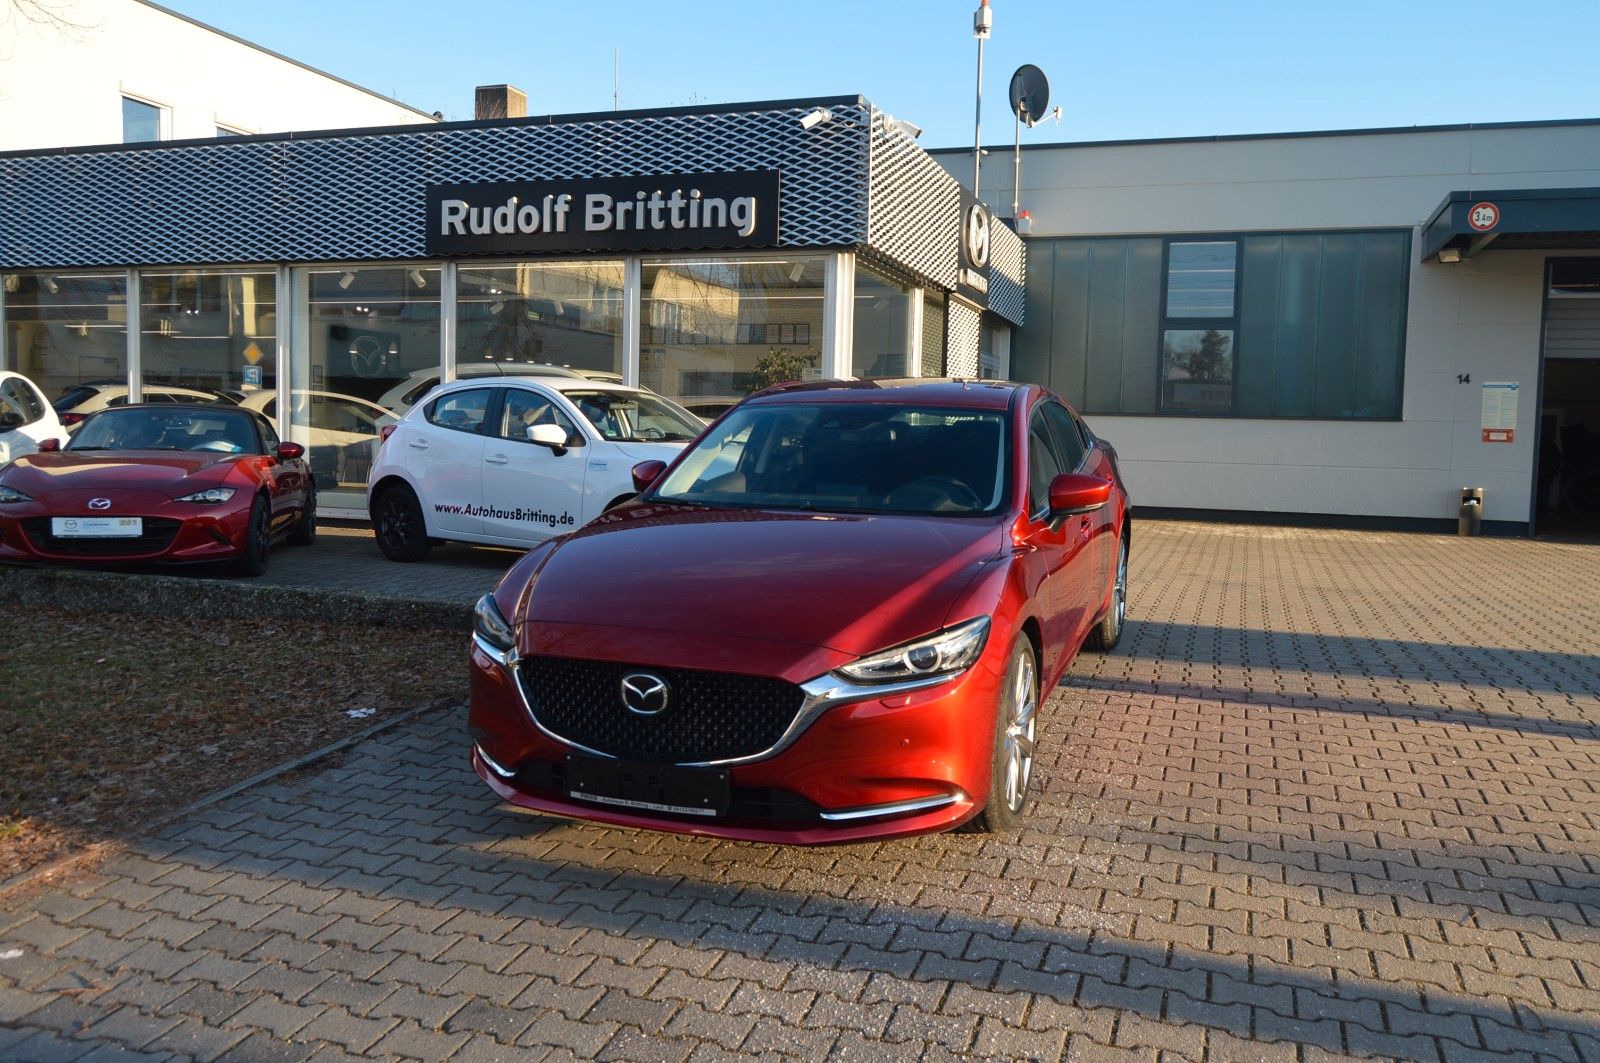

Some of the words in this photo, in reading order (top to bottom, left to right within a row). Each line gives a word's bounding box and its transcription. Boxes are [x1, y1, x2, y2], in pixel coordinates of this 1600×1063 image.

[441, 193, 572, 237] Rudolf
[585, 188, 756, 238] Britting
[1457, 374, 1471, 385] 14
[434, 503, 575, 528] www.AutohausBritting.de
